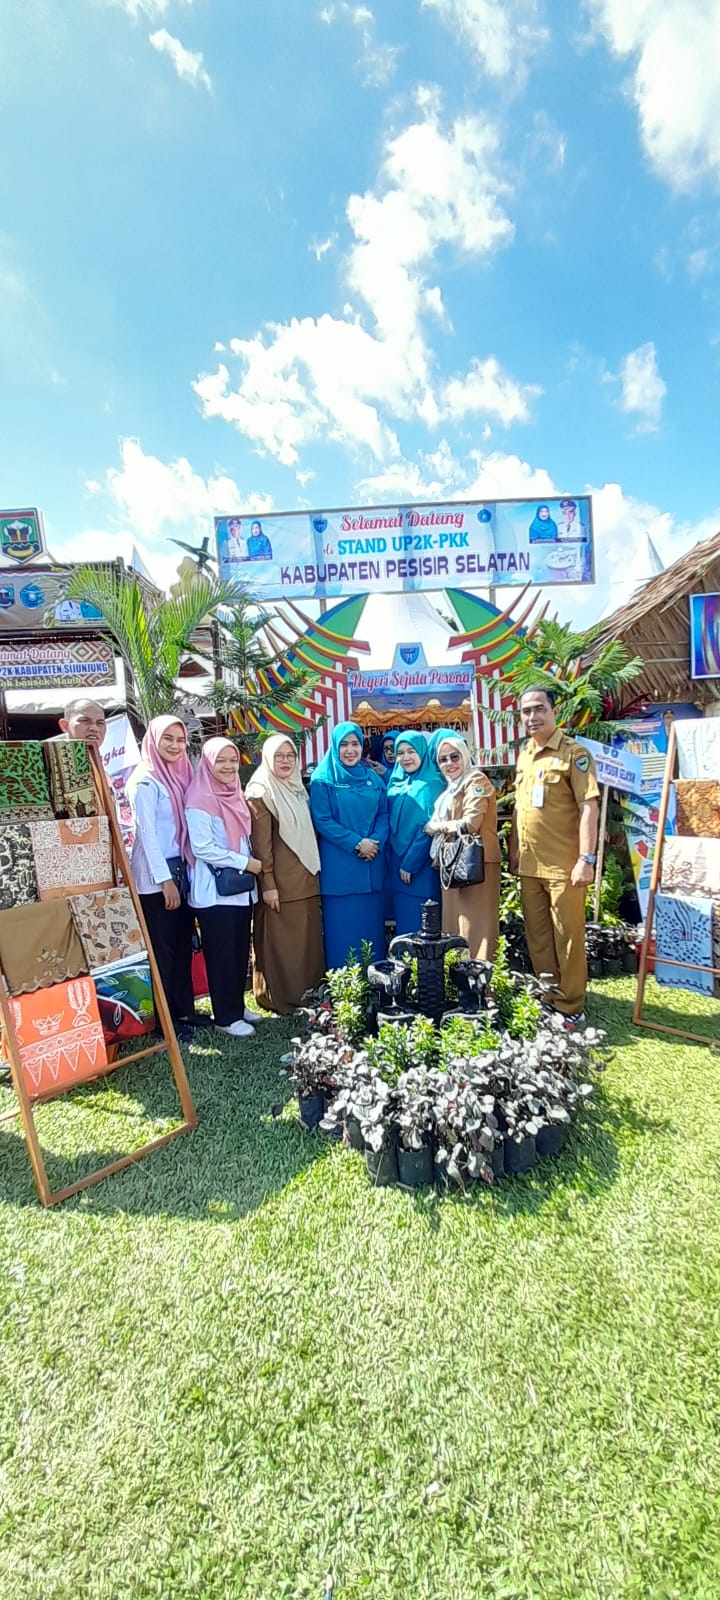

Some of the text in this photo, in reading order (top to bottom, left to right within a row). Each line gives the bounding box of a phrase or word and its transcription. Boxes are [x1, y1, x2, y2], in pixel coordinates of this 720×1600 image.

[342, 510, 465, 532] Selamat Datang
[323, 532, 470, 555] di STAND UP2K-PKK
[280, 551, 530, 585] KABUPATEN PESISIR SELATAN
[29, 647, 71, 660] Datang
[14, 663, 63, 676] KABUPATEN
[64, 662, 108, 674] SIJUNJUNG
[350, 669, 470, 692] Negeri Sejuta Pesona
